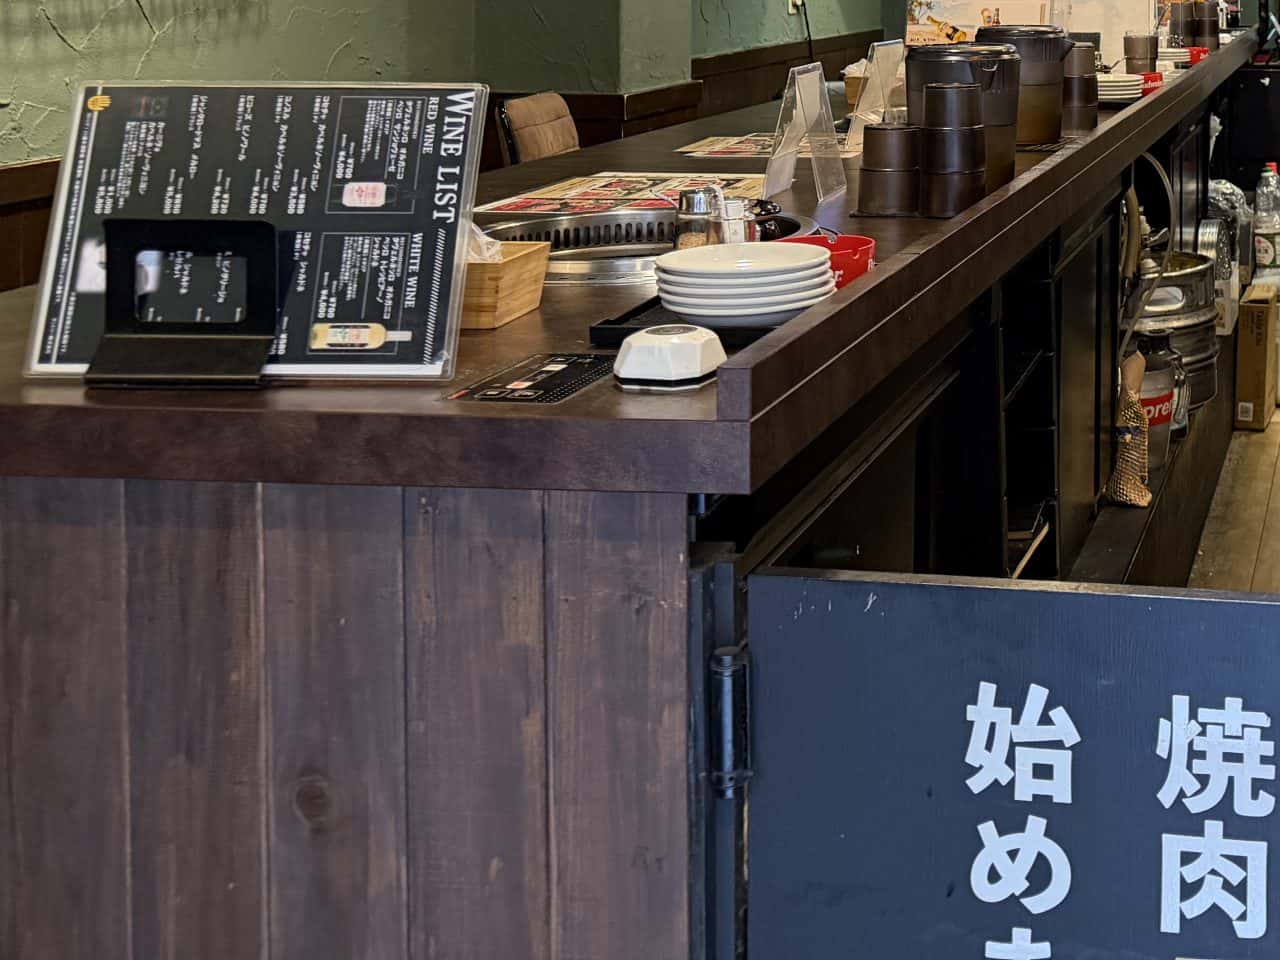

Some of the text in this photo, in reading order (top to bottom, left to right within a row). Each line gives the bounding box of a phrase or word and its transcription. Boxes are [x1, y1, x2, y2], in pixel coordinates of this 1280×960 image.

[422, 97, 439, 153] RED WINE
[433, 91, 475, 222] WINE LIST
[404, 233, 423, 308] WHITE WINE
[1156, 694, 1276, 960] 焼肉
